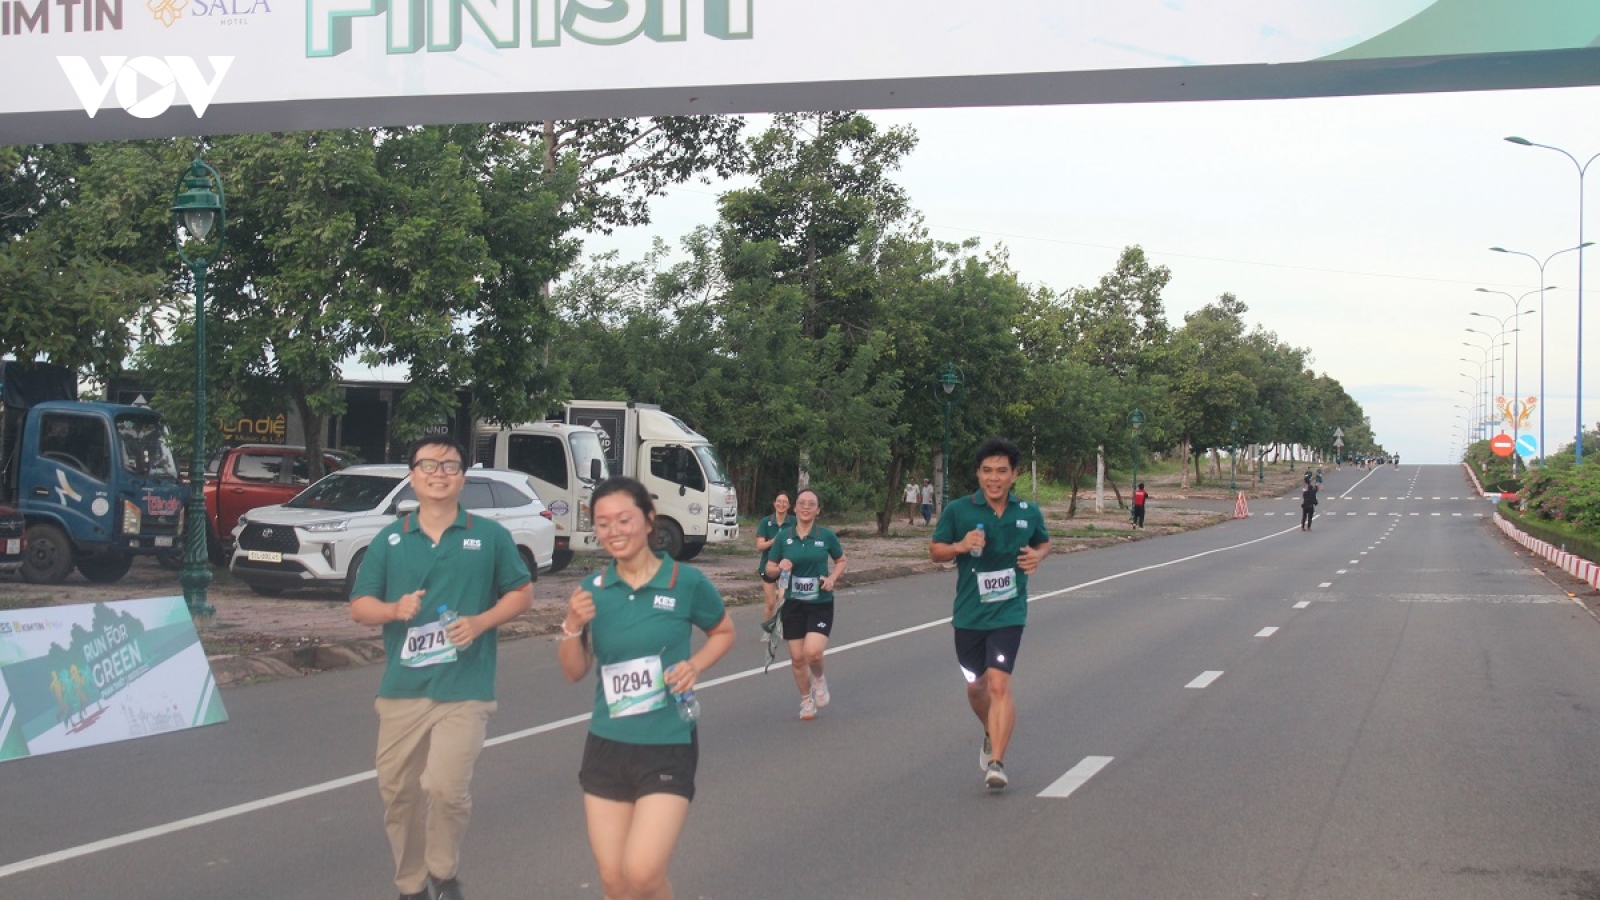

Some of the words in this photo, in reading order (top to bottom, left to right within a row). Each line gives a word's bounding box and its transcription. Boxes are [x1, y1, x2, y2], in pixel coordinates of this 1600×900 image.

[56, 0, 123, 32] TIN
[220, 18, 249, 26] HOTEL
[984, 576, 1010, 590] 0206
[83, 635, 108, 662] RUN
[106, 624, 129, 648] FOR
[408, 630, 445, 652] 0274
[92, 638, 142, 688] GREEN
[612, 669, 652, 694] 0294
